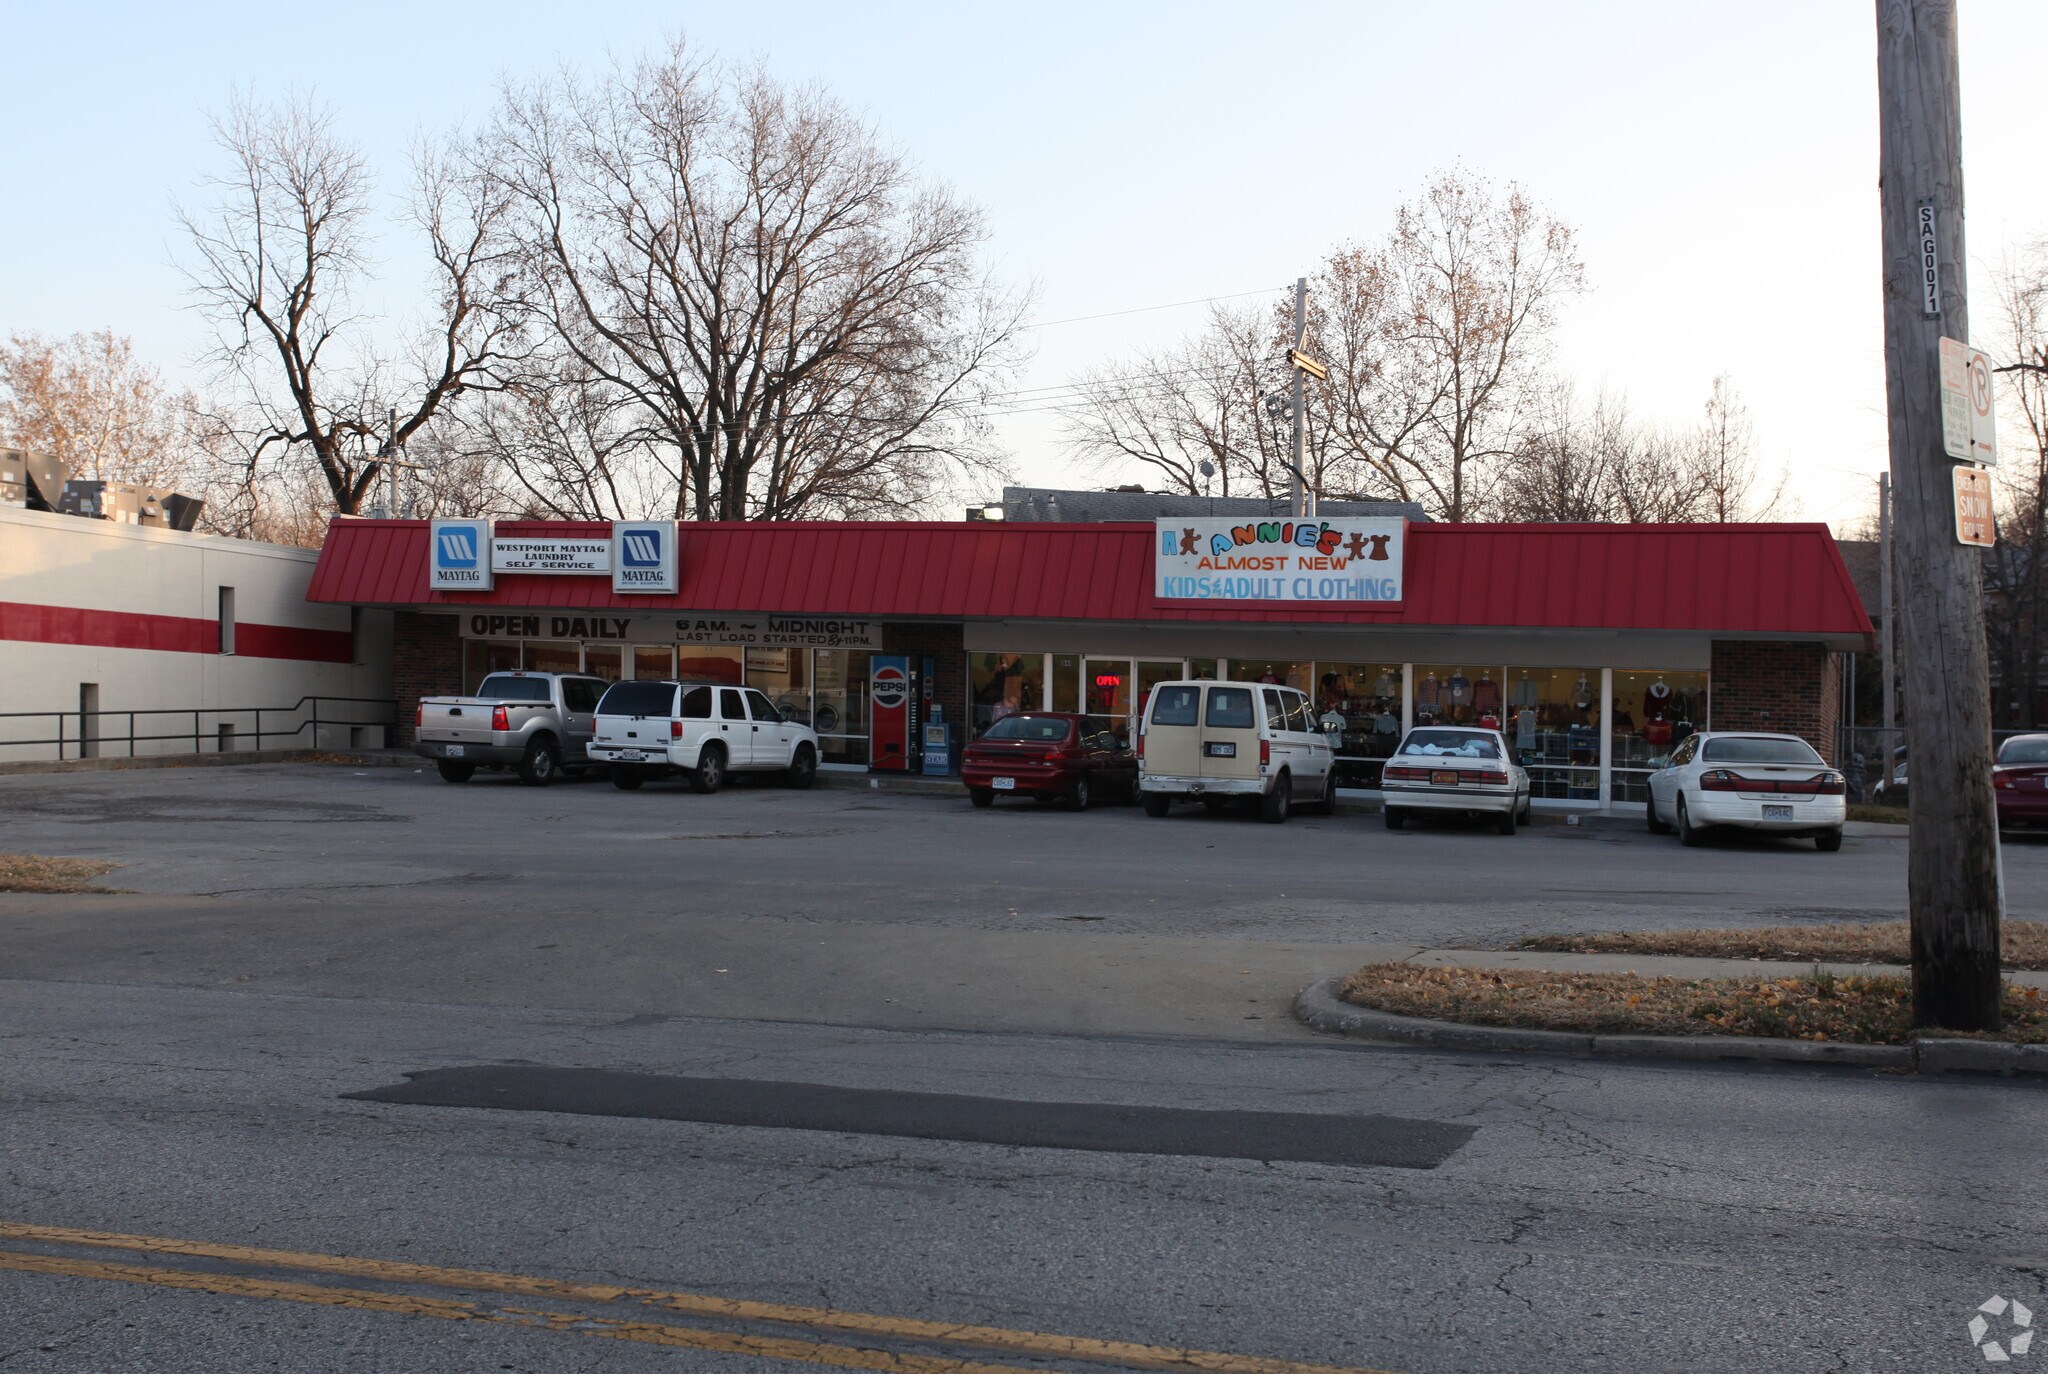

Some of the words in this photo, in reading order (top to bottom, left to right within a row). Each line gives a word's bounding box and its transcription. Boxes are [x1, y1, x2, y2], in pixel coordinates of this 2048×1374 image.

[1956, 475, 1988, 493] EMERENCY
[1960, 495, 1988, 519] SNOW
[1963, 522, 1985, 539] ROUTE
[1210, 521, 1343, 556] ANNIE'S
[496, 544, 557, 552] WESTPORT
[560, 545, 605, 553] MAYTAG
[524, 553, 575, 561] LAUNDRY
[541, 561, 595, 569] SERVICE
[1197, 556, 1289, 571] ALMOST
[1298, 556, 1349, 571] NEW
[437, 570, 480, 581] MAYTAG
[622, 570, 664, 581] MAYTAG
[1292, 578, 1397, 600] CLOTHING
[471, 614, 540, 636] OPEN
[551, 616, 631, 639] DAILY
[768, 620, 869, 635] MIDNIGHT
[676, 632, 712, 641] LAST
[719, 633, 756, 642] LOAD
[763, 634, 827, 644] STARTED
[1095, 675, 1121, 686] OPEN
[872, 681, 906, 693] PEPSI
[926, 753, 948, 764] STAR
